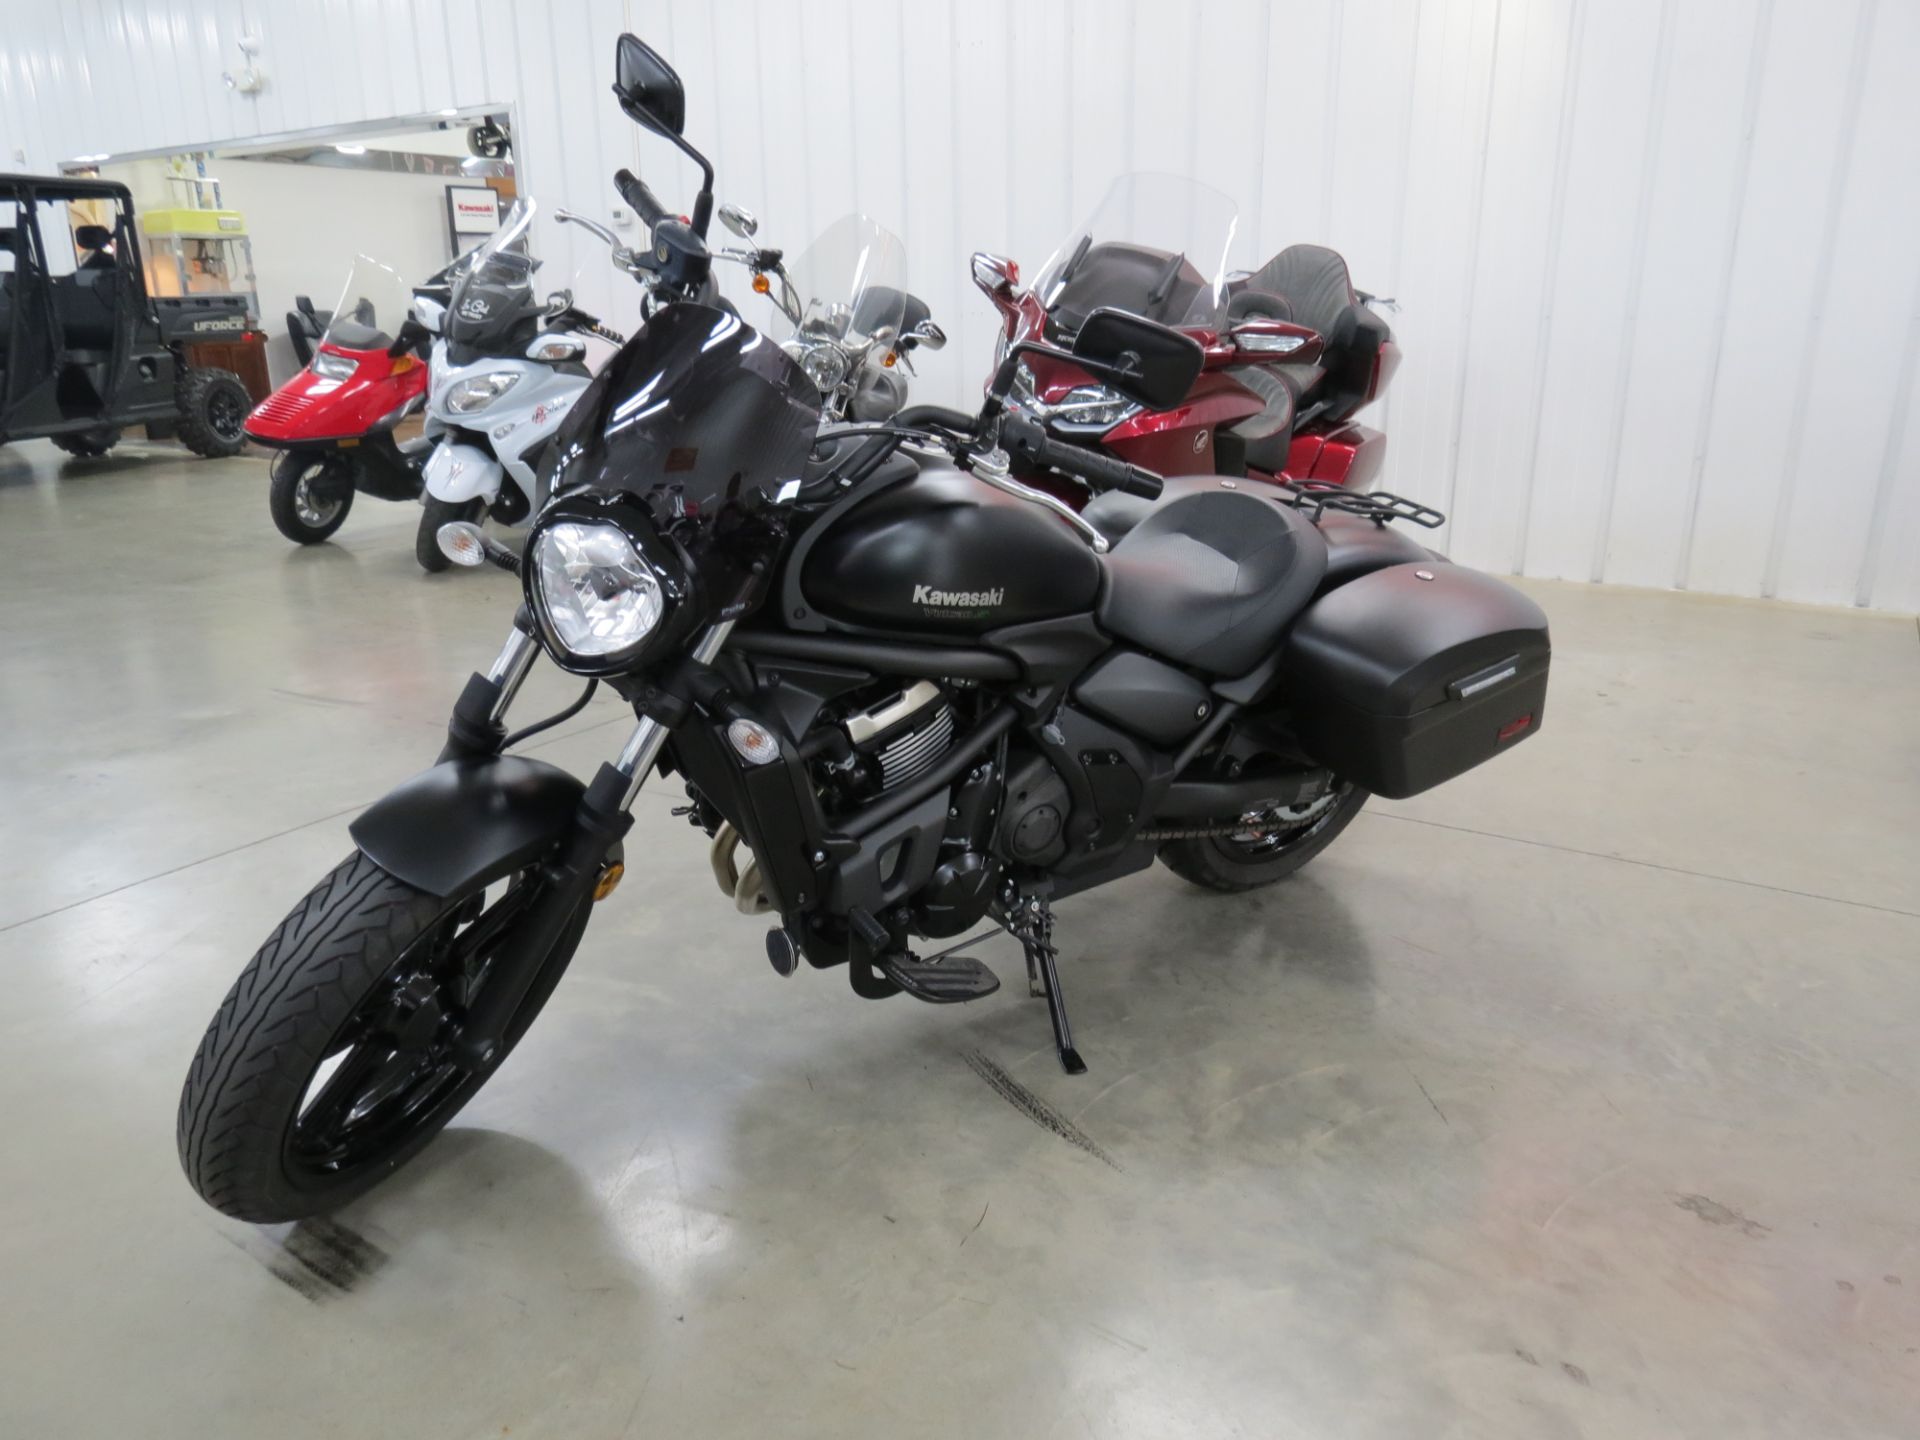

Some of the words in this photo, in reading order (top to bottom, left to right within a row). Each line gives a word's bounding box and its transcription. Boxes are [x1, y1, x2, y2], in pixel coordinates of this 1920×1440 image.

[458, 203, 494, 212] Kawasaki
[194, 320, 244, 332] UFORCE
[912, 584, 1004, 607] Kawasaki
